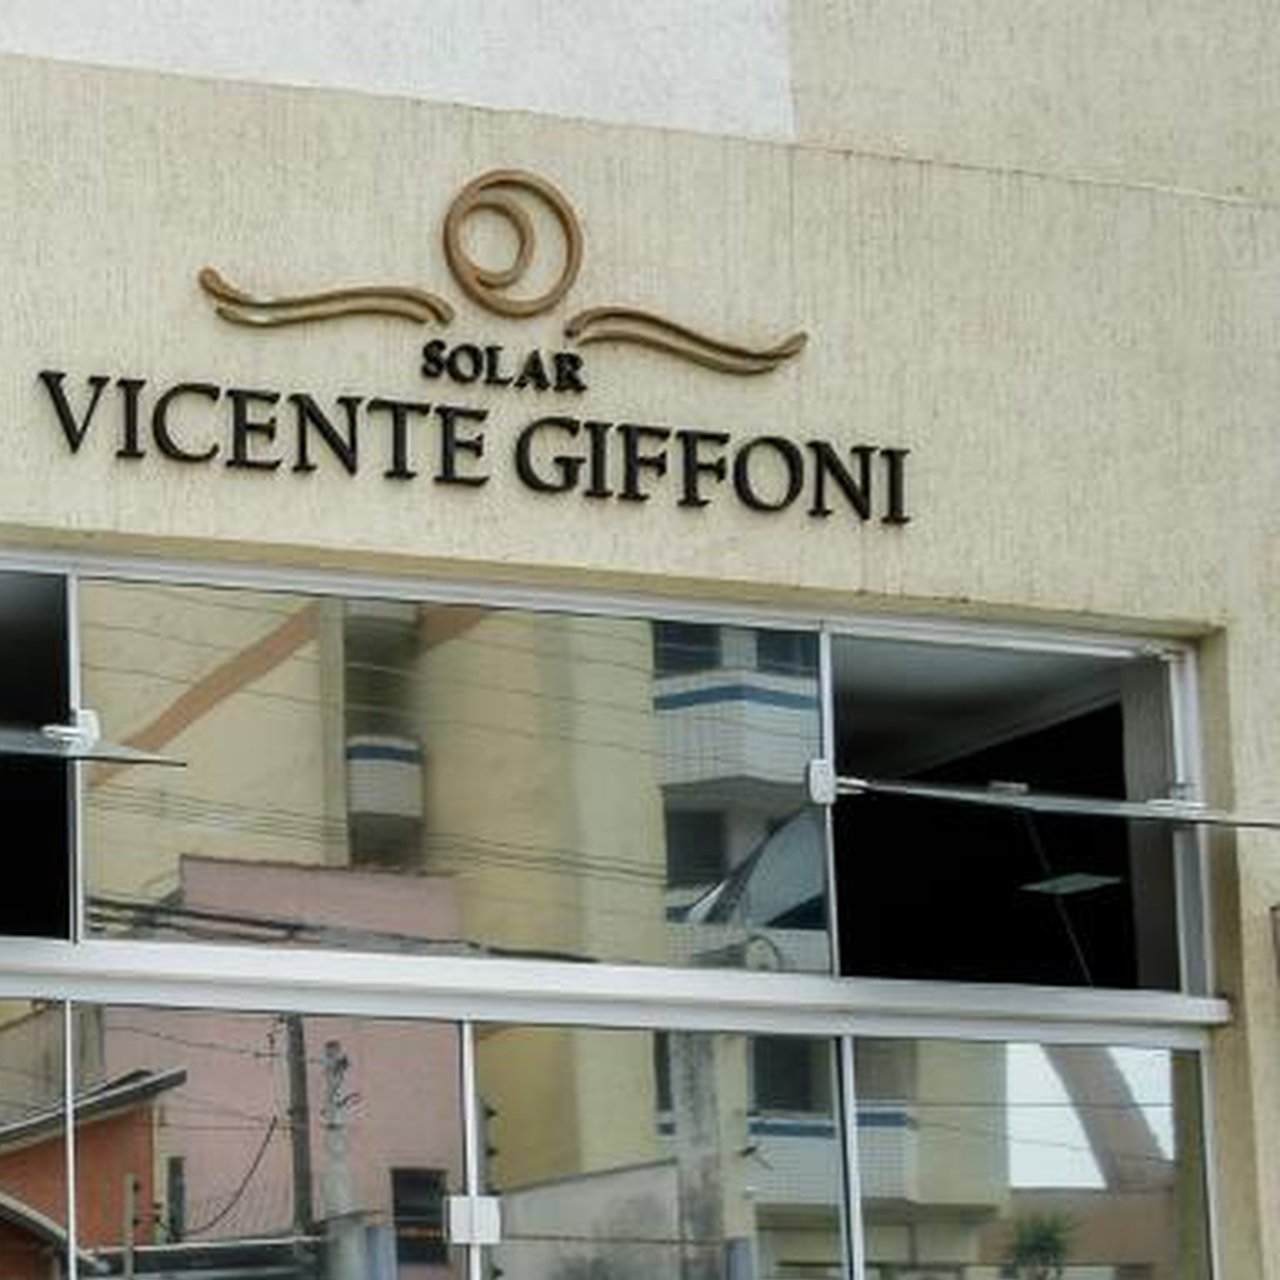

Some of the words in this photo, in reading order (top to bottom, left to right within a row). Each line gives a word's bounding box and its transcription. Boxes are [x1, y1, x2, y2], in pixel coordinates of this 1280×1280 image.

[421, 339, 588, 394] SOLAR
[37, 370, 489, 488] VICENTE
[514, 415, 912, 525] GIFFONI
